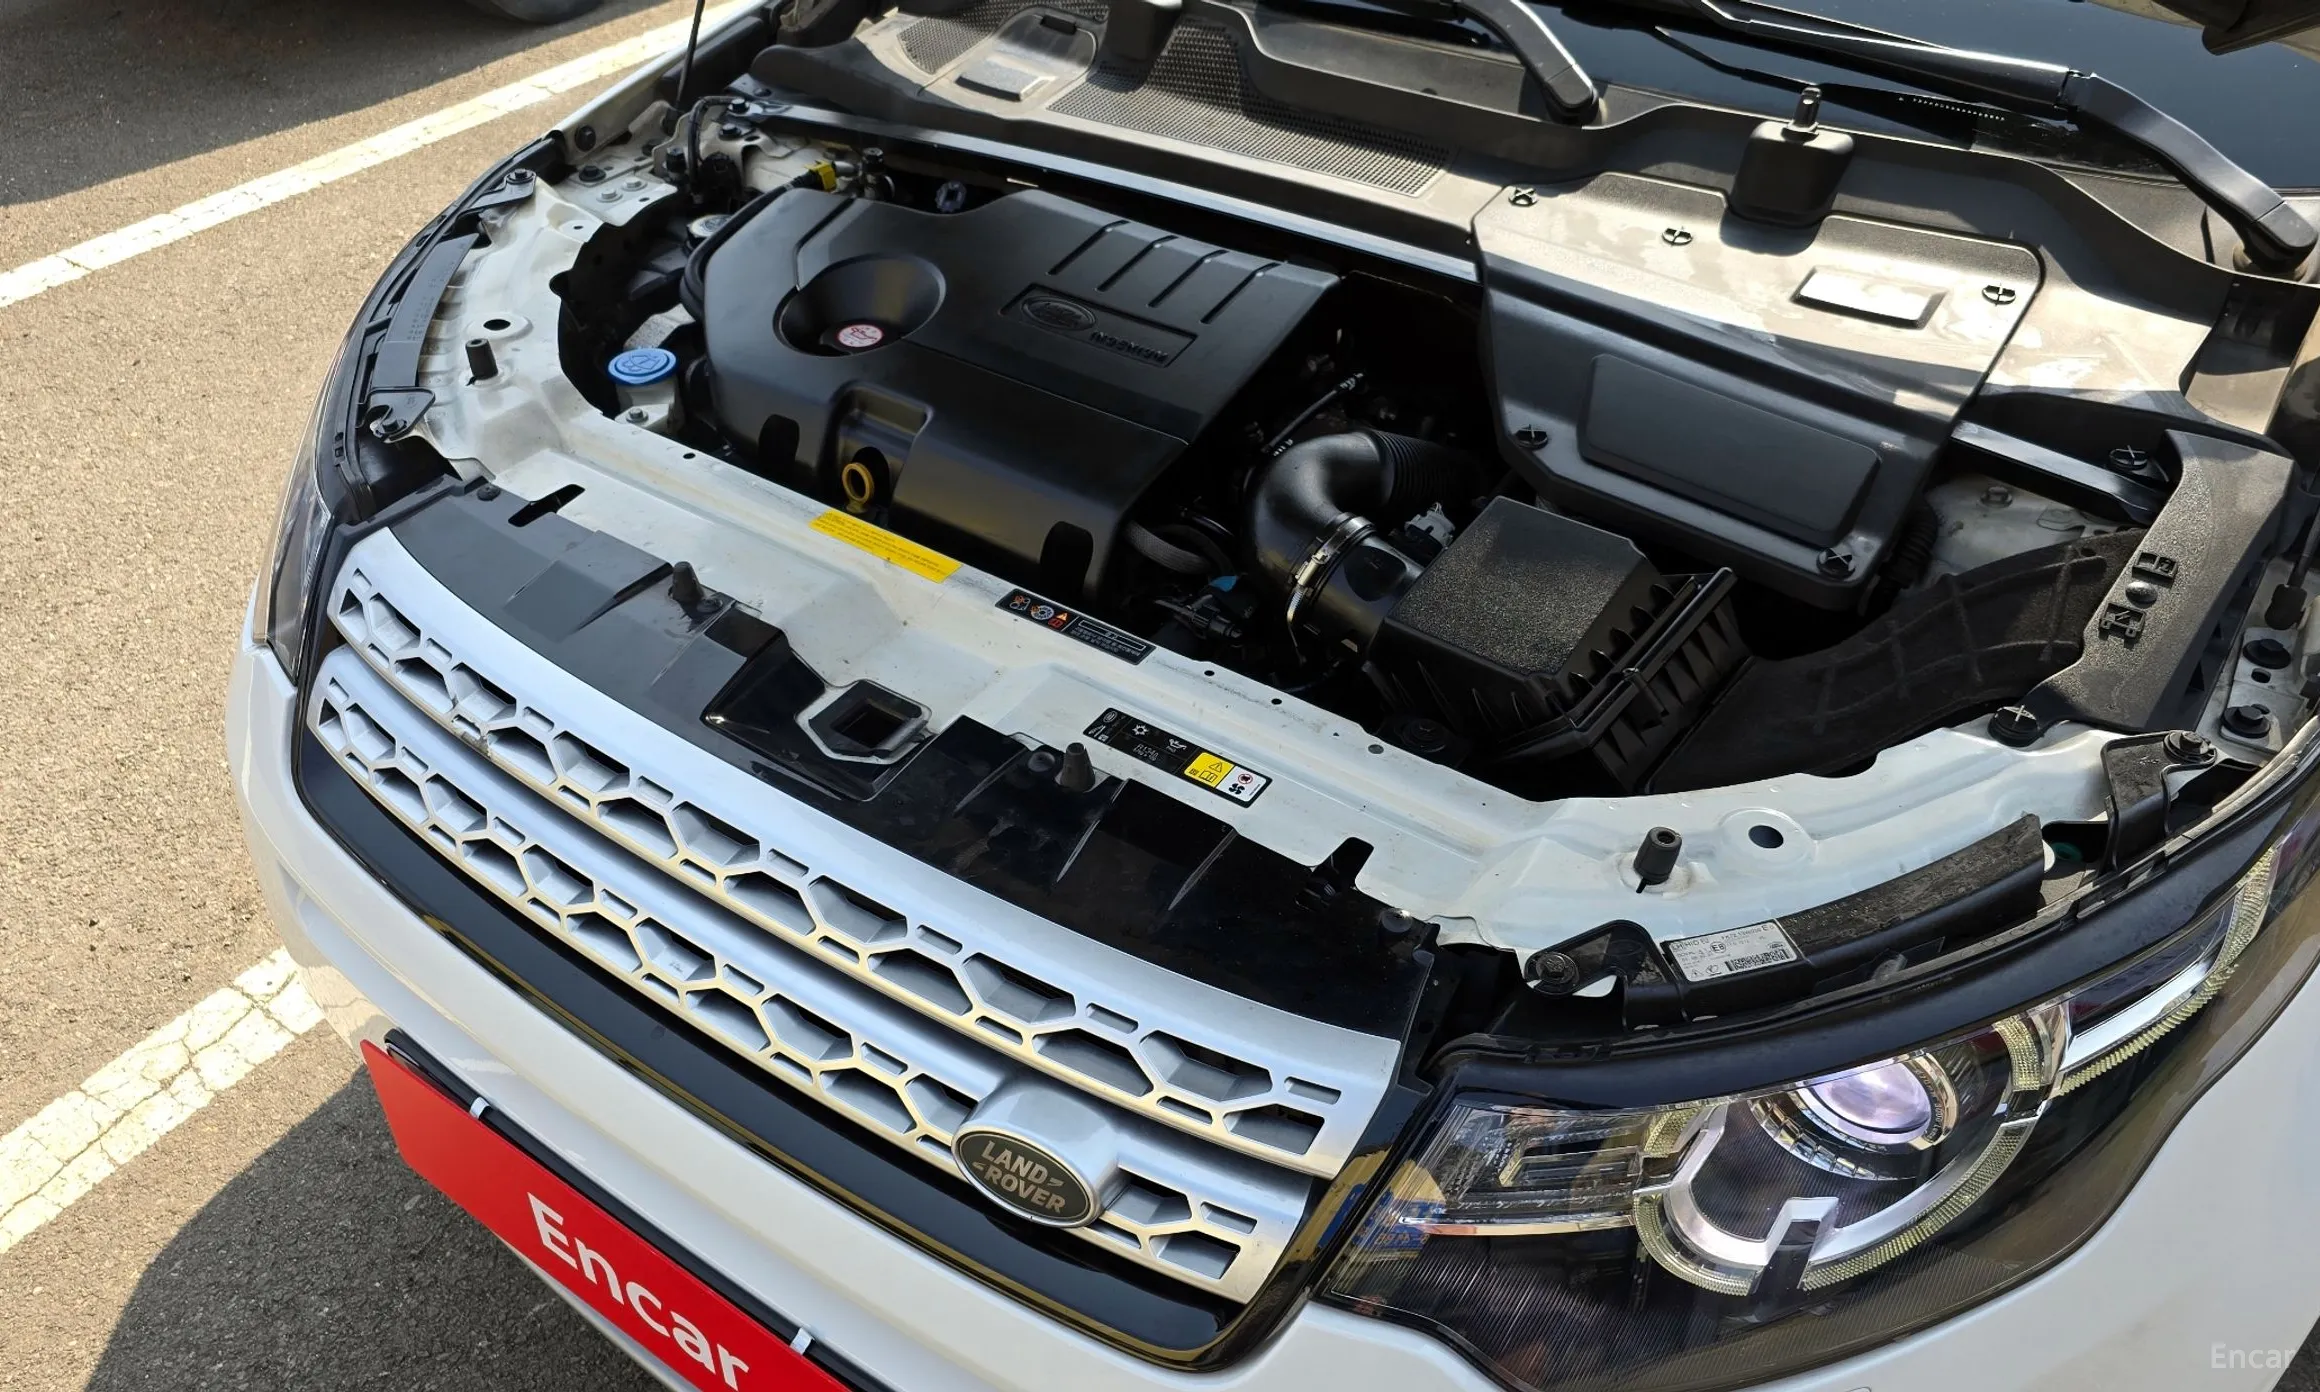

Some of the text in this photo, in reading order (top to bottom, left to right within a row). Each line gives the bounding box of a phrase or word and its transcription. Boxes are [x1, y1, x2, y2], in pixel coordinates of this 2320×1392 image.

[981, 1140, 1048, 1186] LAND
[984, 1163, 1066, 1214] ROVER
[527, 1191, 750, 1391] Encar
